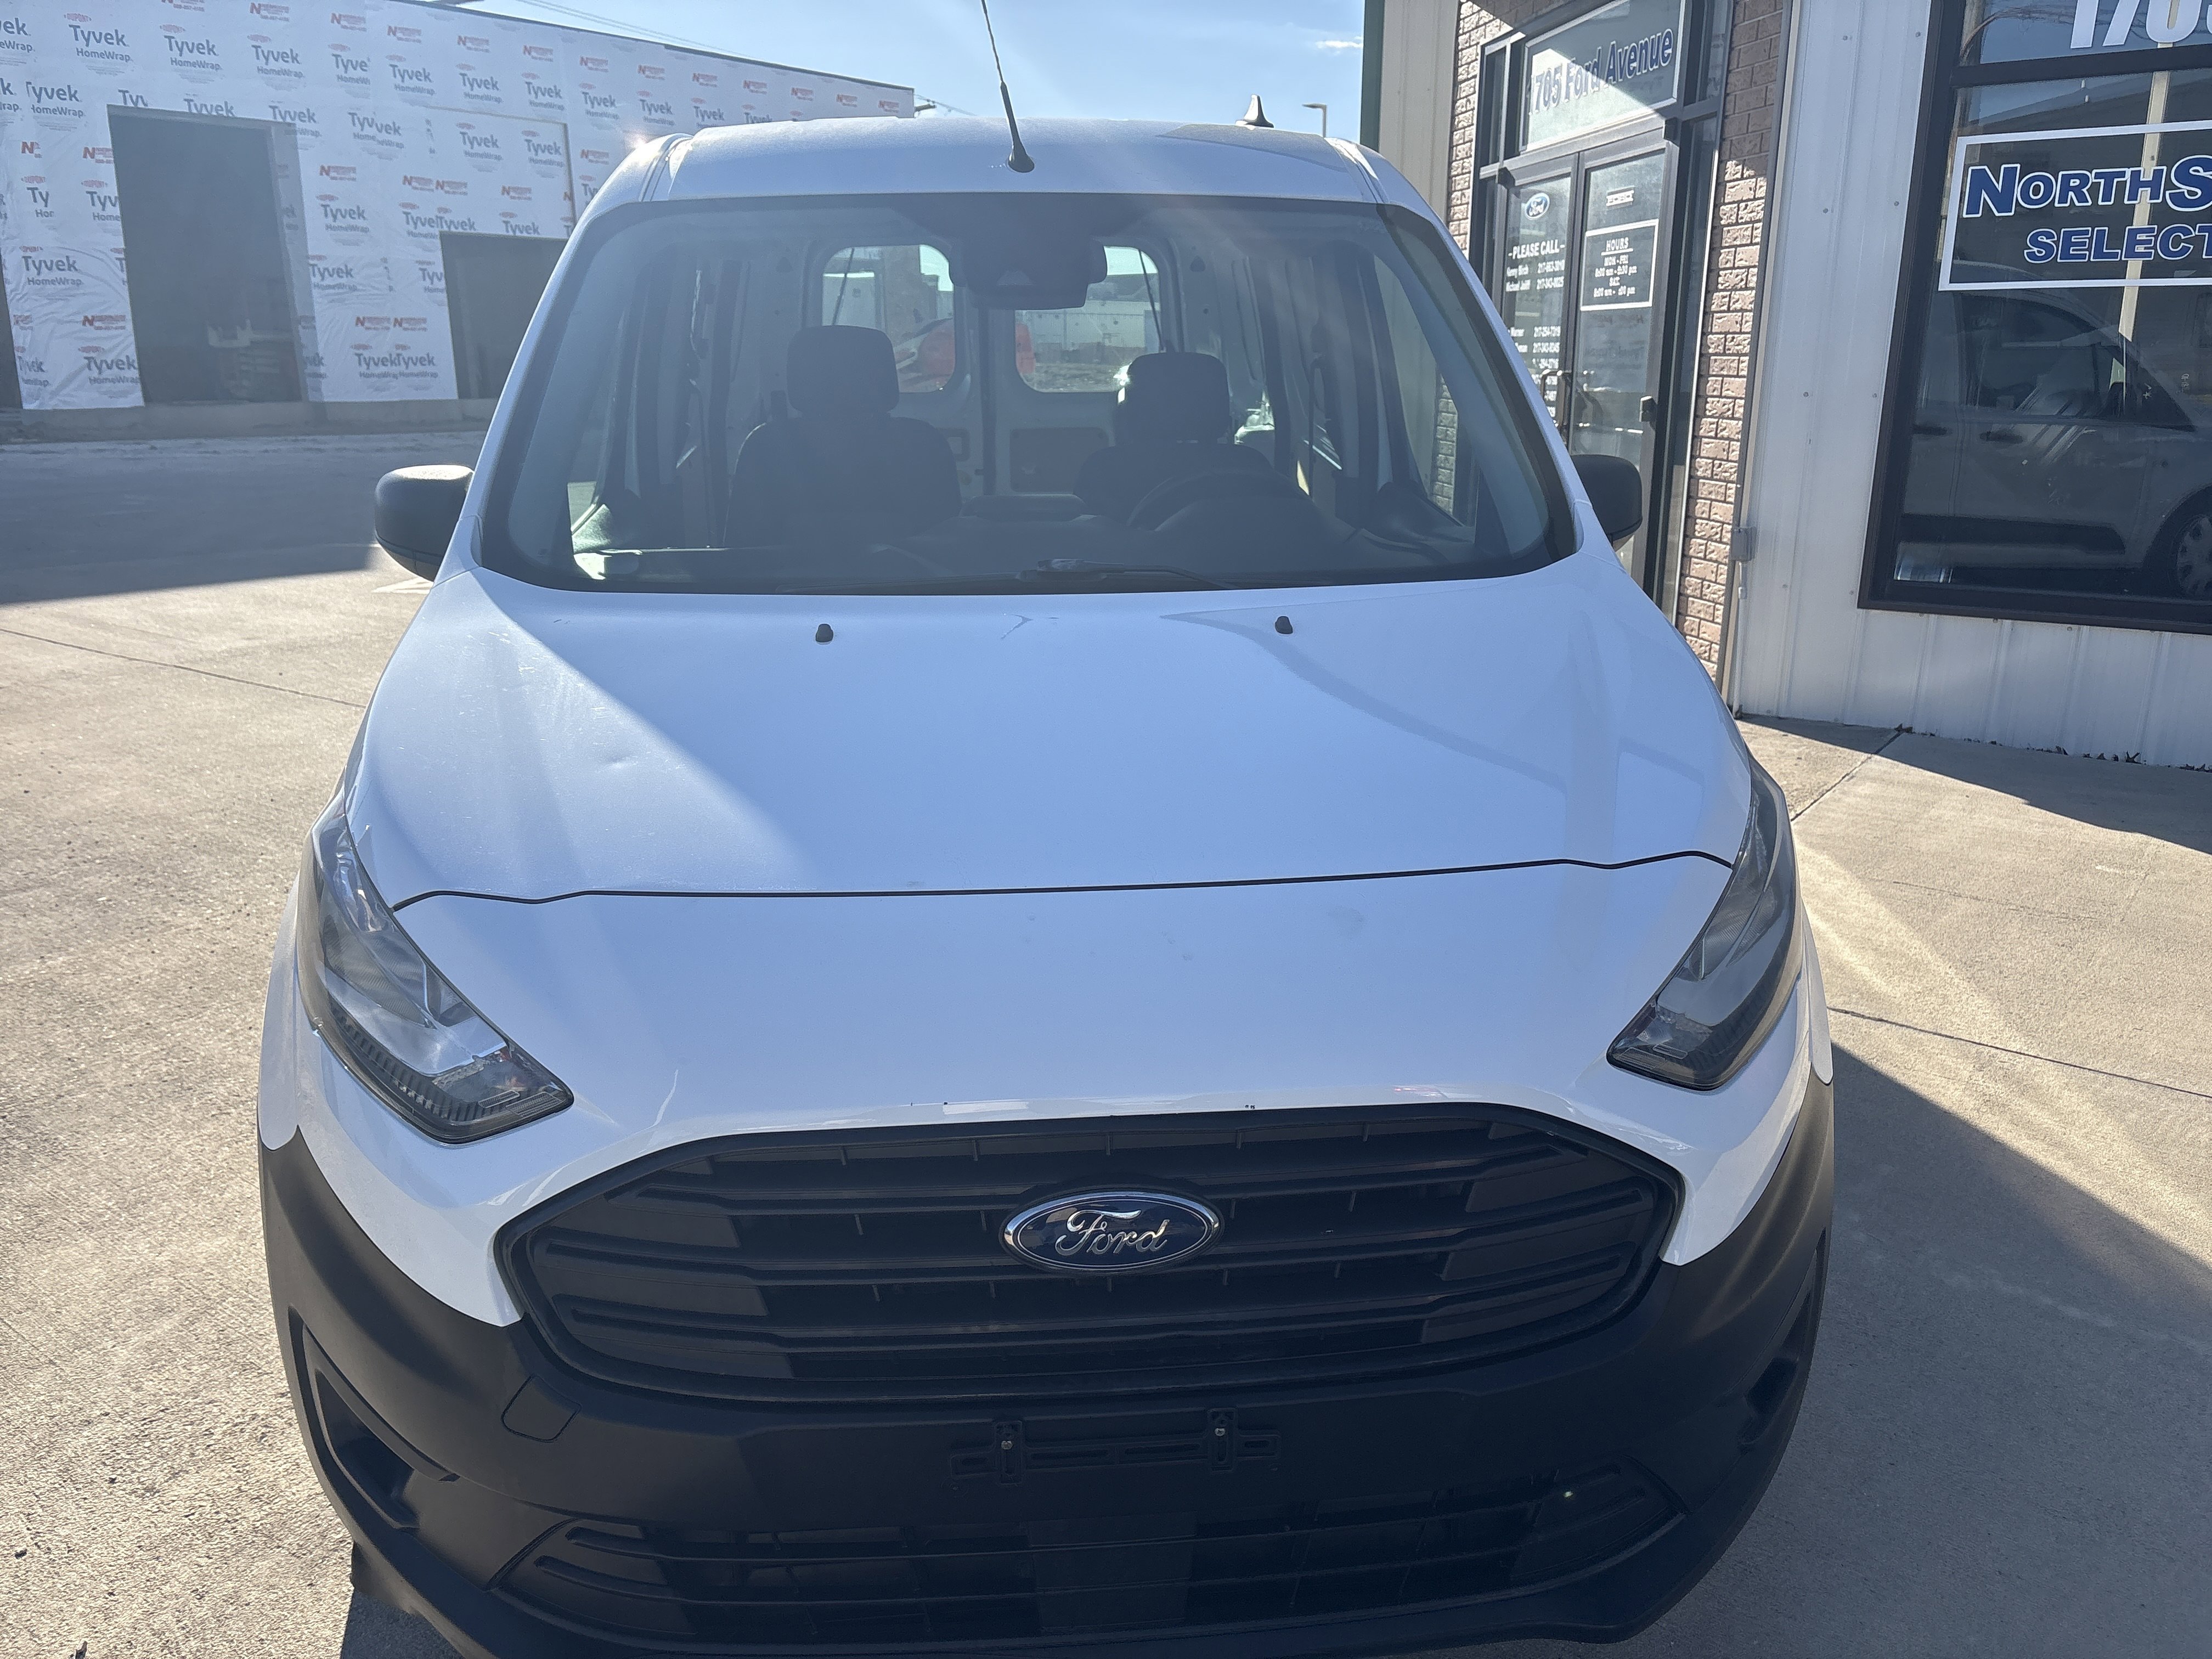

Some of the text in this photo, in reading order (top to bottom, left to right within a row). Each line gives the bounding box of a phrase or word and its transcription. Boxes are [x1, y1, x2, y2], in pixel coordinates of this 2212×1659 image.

[69, 24, 127, 47] Tyvek
[164, 35, 217, 57] Tyvek
[251, 44, 300, 65] Tyvek
[76, 48, 131, 63] HomeWrap
[170, 57, 221, 71] HomeWrap
[389, 64, 432, 83] Tyvek
[1564, 46, 1601, 103] Ford
[1605, 28, 1673, 88] Avenue
[459, 73, 500, 91] Tyvek
[525, 82, 562, 99] Tyvek
[582, 92, 616, 108] Tyvek
[640, 99, 673, 115] Tyvek
[460, 131, 499, 149] Tyvek
[525, 139, 562, 156] Tyvek
[321, 204, 366, 222] Tyvek
[503, 220, 540, 236] Tyvek
[1606, 236, 1629, 252] HOURS
[22, 256, 78, 275] Tyvek
[311, 264, 354, 281] Tyvek
[27, 277, 82, 286] HomeWrap
[83, 355, 137, 374] Tyvek
[1056, 1209, 1170, 1256] Ford
